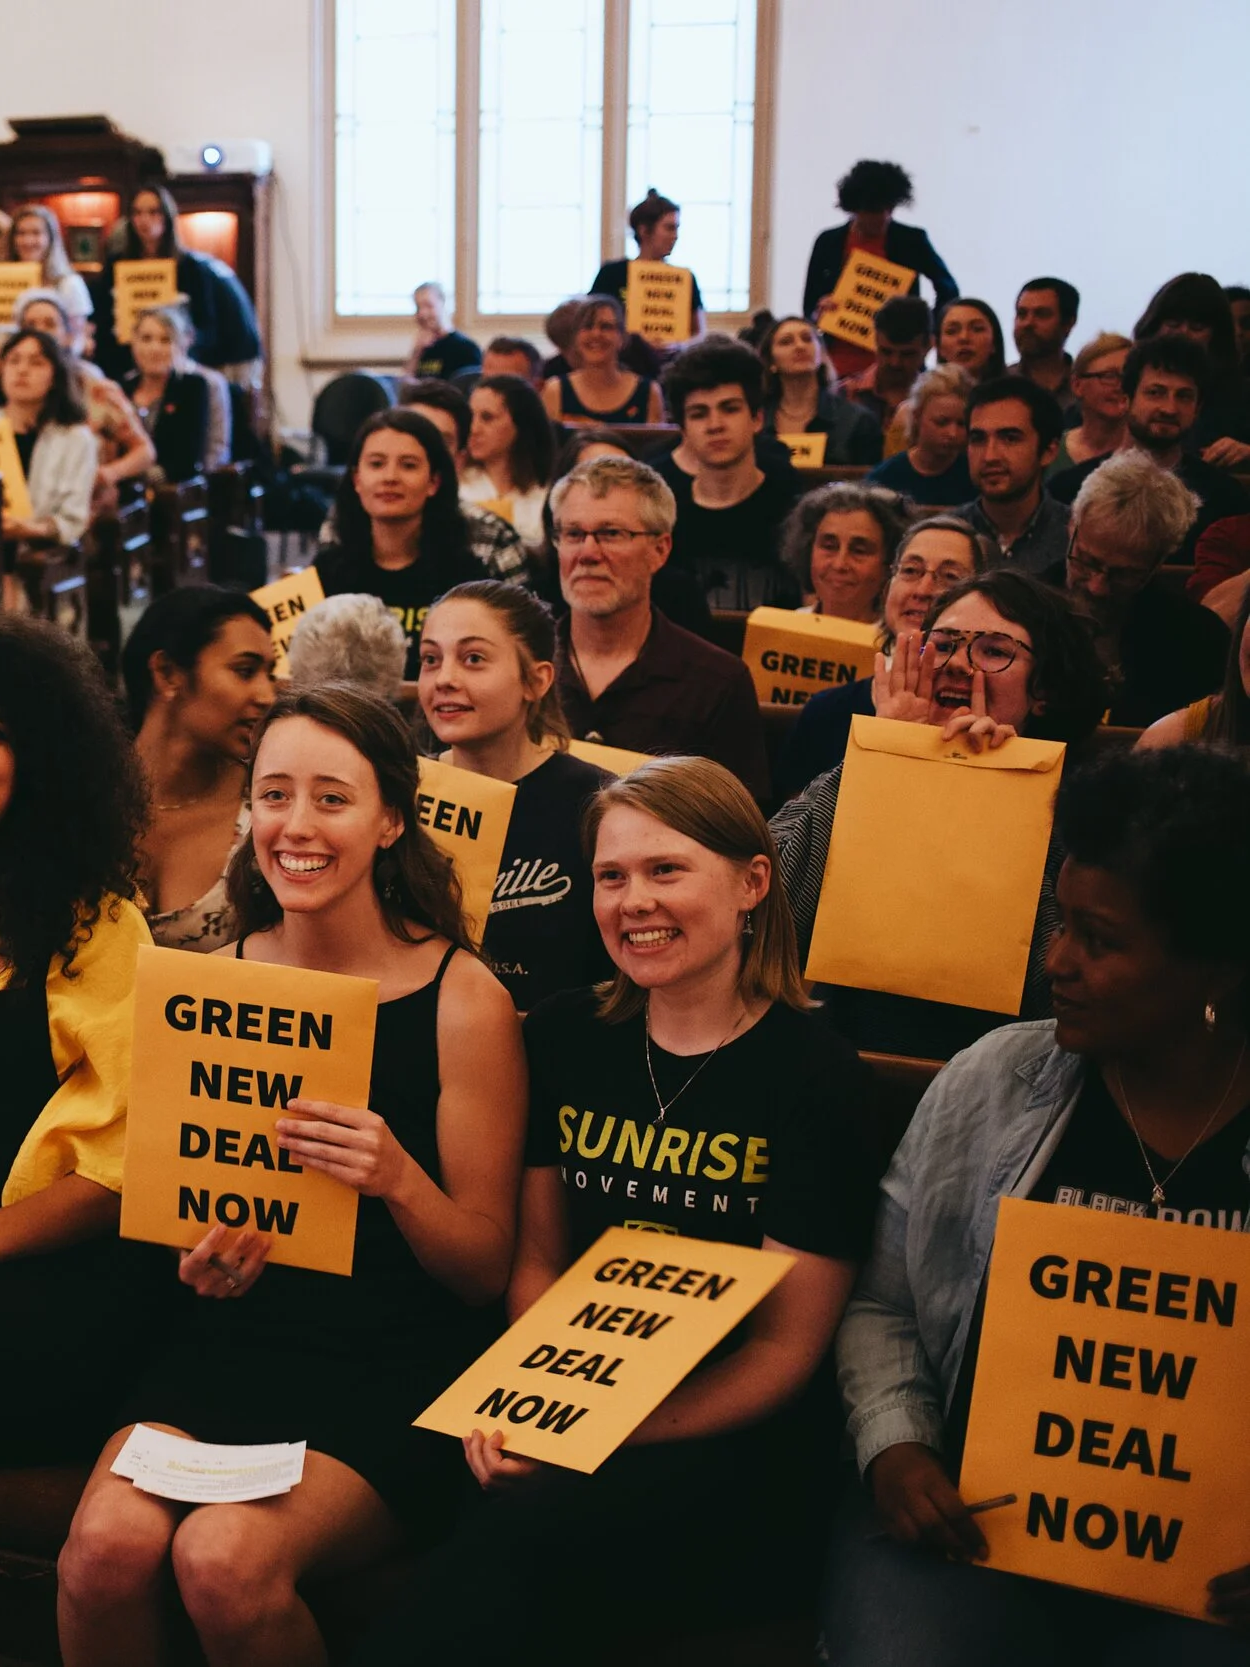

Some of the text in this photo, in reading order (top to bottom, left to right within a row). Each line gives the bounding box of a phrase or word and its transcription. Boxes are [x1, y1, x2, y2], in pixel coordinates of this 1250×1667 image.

[761, 649, 858, 683] GREEN
[770, 686, 812, 705] NE
[417, 793, 483, 841] EEN
[164, 994, 333, 1050] GREEN
[190, 1060, 303, 1110] NEW
[179, 1122, 303, 1174] DEAL
[558, 1105, 769, 1183] SUNRISE
[178, 1185, 299, 1236] NOW
[594, 1257, 737, 1301] GREEN
[1029, 1254, 1237, 1327] GREEN
[569, 1302, 673, 1340] NEW
[519, 1344, 624, 1387] DEAL
[1053, 1335, 1197, 1400] NEW
[474, 1387, 589, 1435] NOW
[1034, 1411, 1191, 1482] DEAL
[1026, 1491, 1183, 1563] NOW
